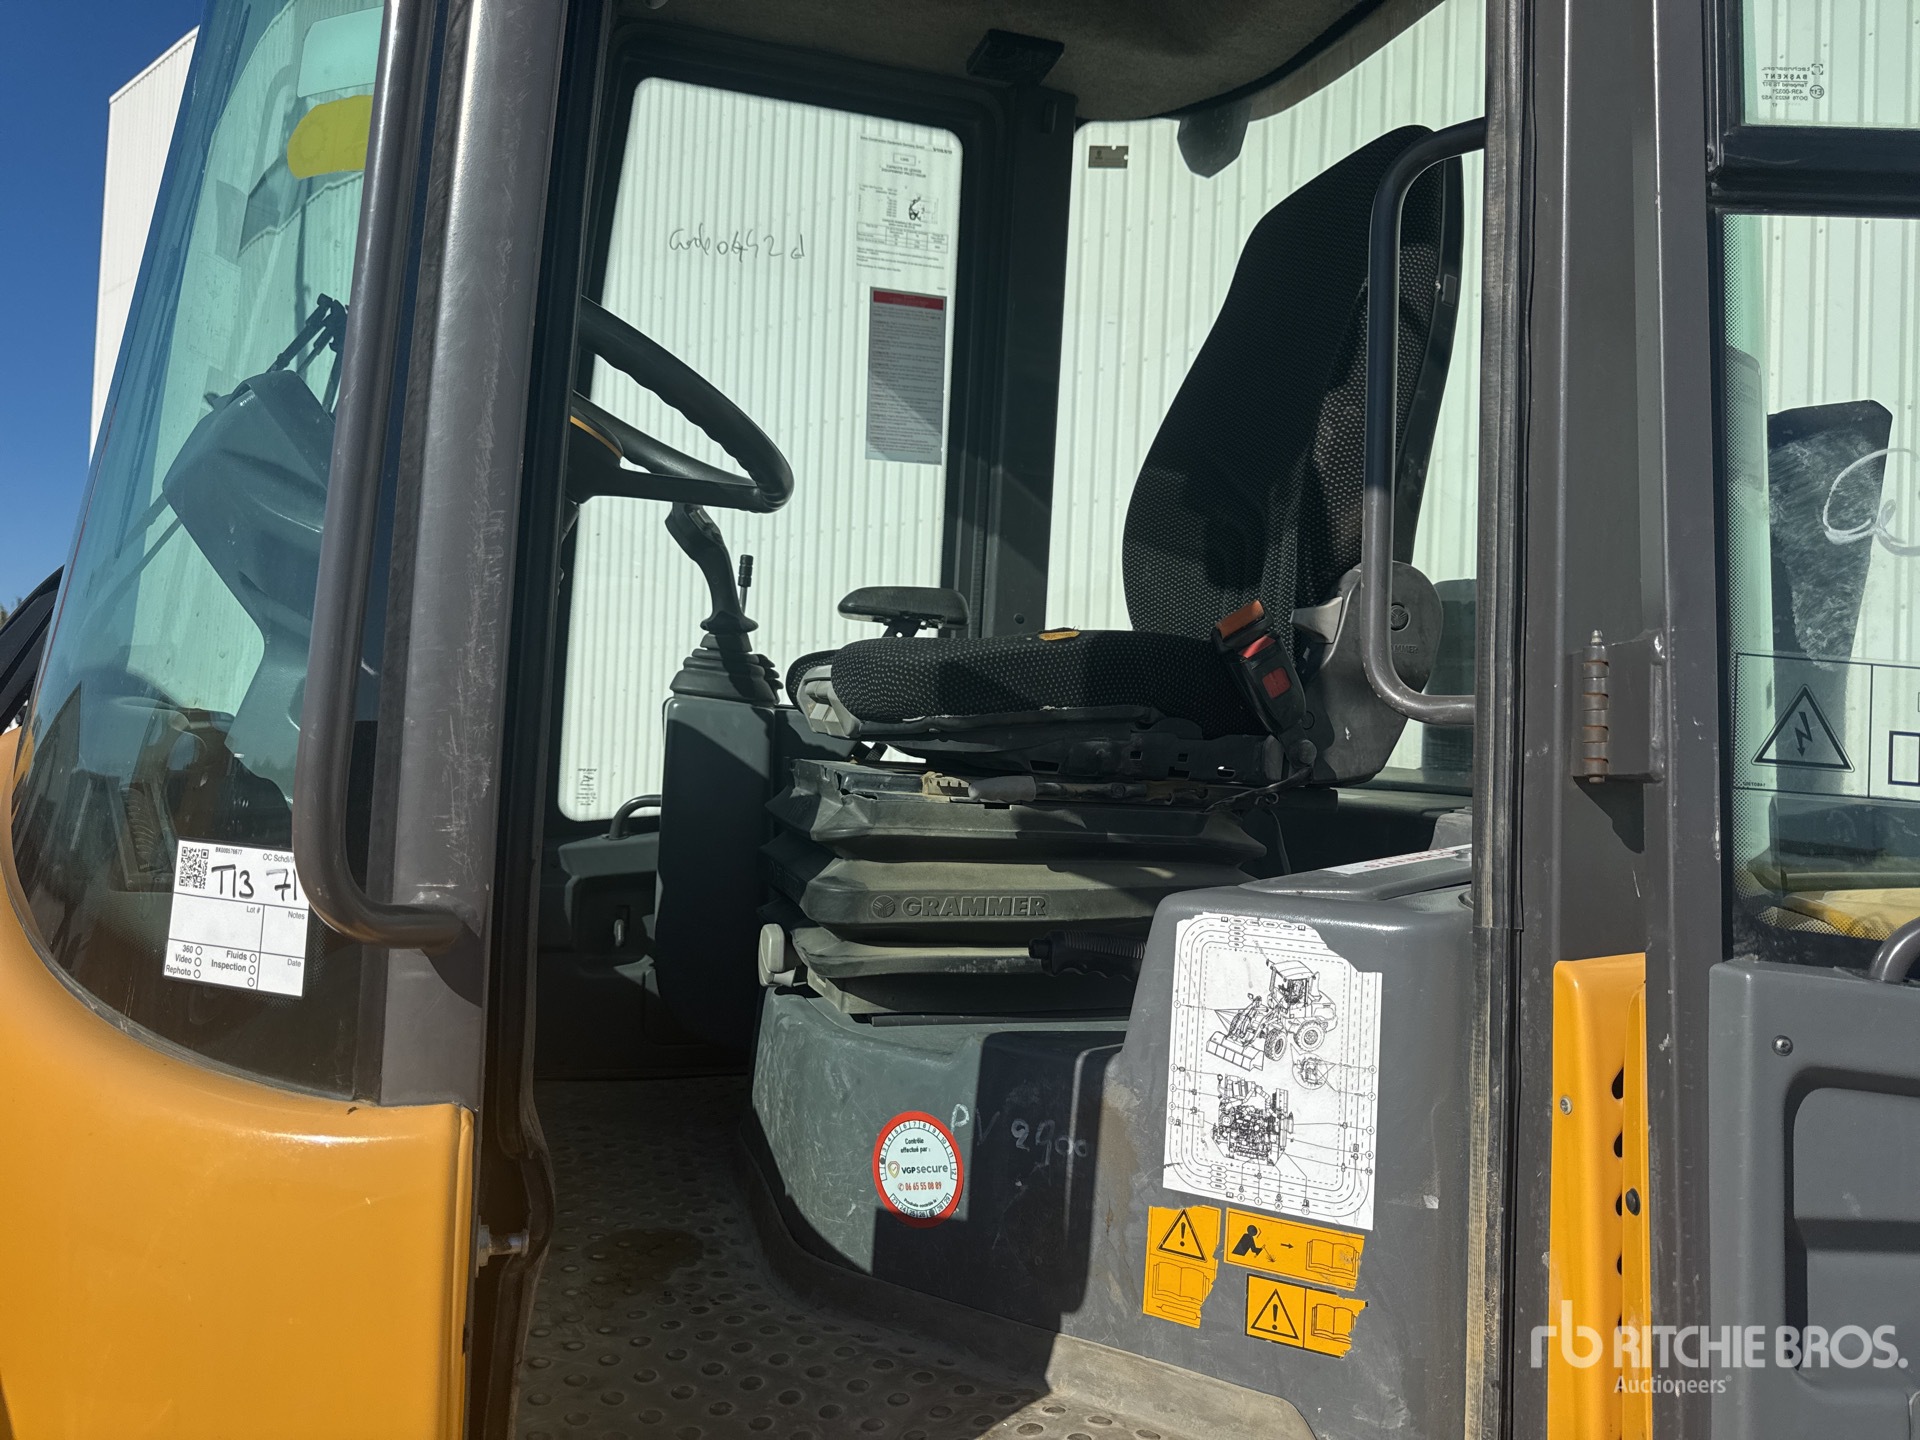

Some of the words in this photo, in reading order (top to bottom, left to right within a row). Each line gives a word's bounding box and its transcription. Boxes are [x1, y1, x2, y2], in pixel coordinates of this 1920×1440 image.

[902, 896, 1047, 917] GRAMMER
[288, 911, 305, 920] Notes
[182, 944, 193, 954] 360
[175, 954, 192, 964] Video
[226, 950, 247, 960] Fluids
[211, 959, 246, 972] Inspection
[287, 958, 301, 967] Date
[166, 964, 191, 976] Rephoto
